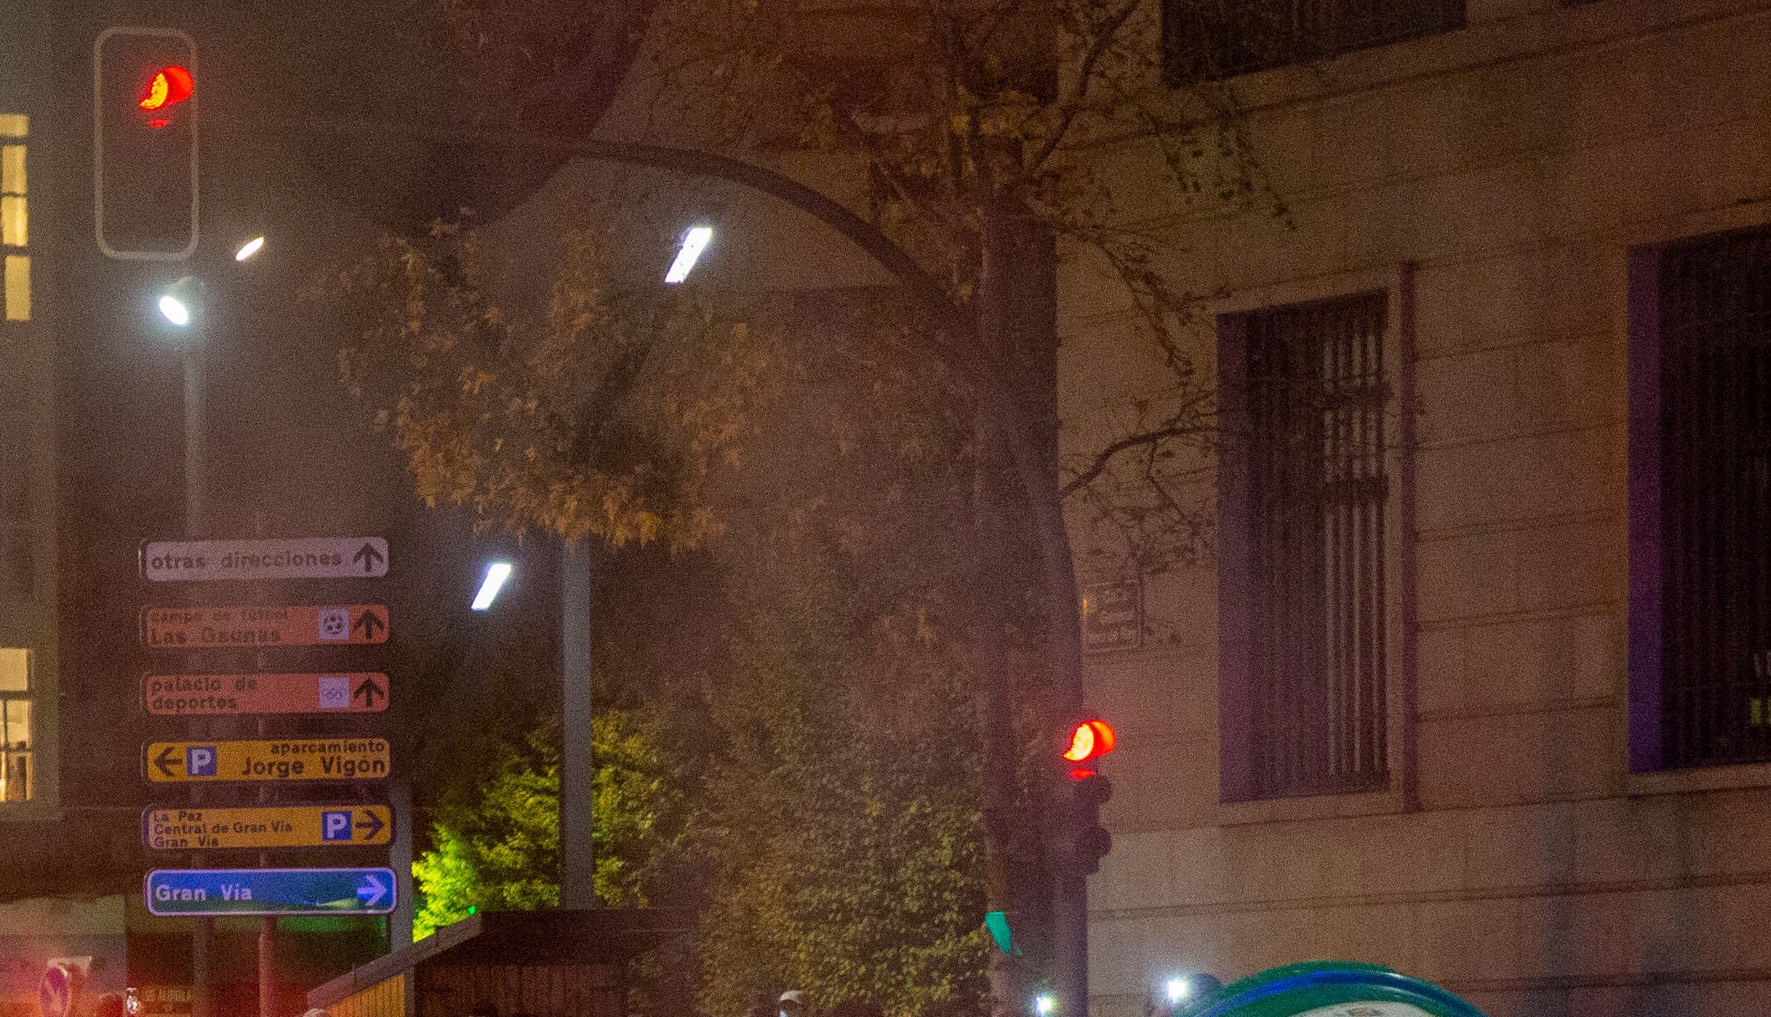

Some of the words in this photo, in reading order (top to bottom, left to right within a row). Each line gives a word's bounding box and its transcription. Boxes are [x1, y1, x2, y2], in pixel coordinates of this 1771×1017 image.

[151, 553, 206, 569] otras
[220, 550, 343, 568] direcciones
[150, 628, 187, 644] Las
[151, 677, 222, 696] palacio
[234, 676, 258, 692] de
[152, 696, 238, 712] deportes
[271, 740, 385, 755] aparcamiento
[190, 750, 212, 775] P
[241, 757, 305, 778] Jorge
[320, 755, 385, 777] Vigón
[154, 811, 170, 822] La
[178, 811, 203, 822] Paz
[154, 823, 208, 835] Central
[211, 823, 230, 834] de
[232, 821, 268, 834] Gran
[326, 813, 348, 839] P
[153, 836, 189, 848] Gran
[155, 884, 206, 901] Gran
